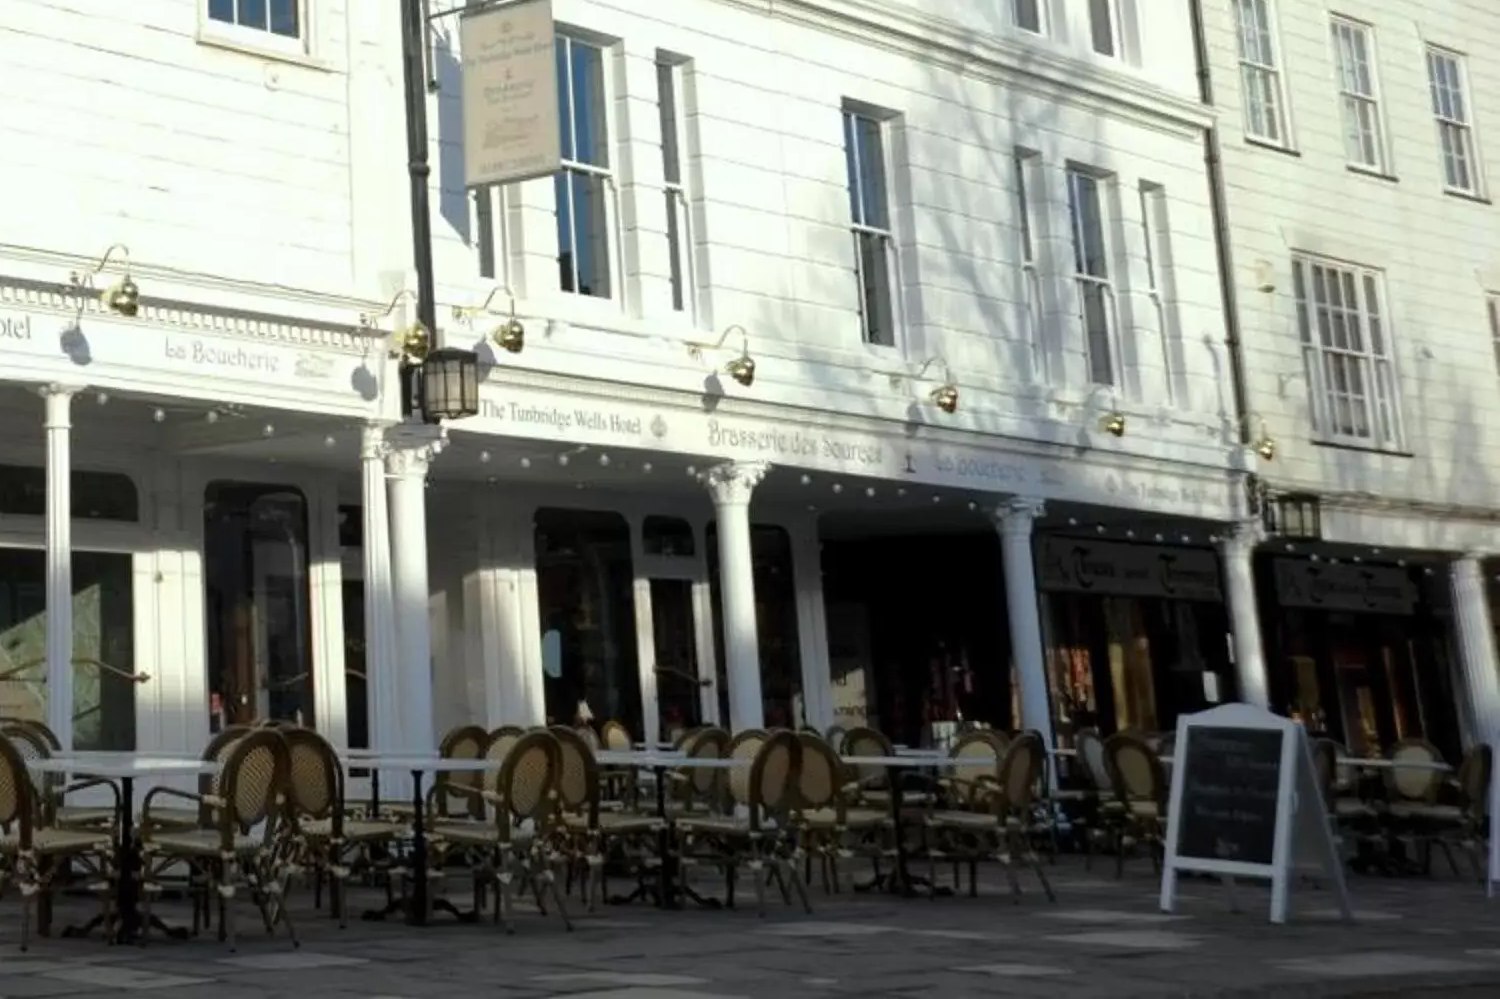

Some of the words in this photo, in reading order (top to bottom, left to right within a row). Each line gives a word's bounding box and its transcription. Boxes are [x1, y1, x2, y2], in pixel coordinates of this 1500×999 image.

[192, 341, 280, 373] Boucherie
[481, 399, 506, 420] The
[509, 402, 571, 431] Tunbridge
[573, 409, 608, 431] Wells
[610, 414, 642, 435] Hotel
[708, 419, 787, 453] Brasserie
